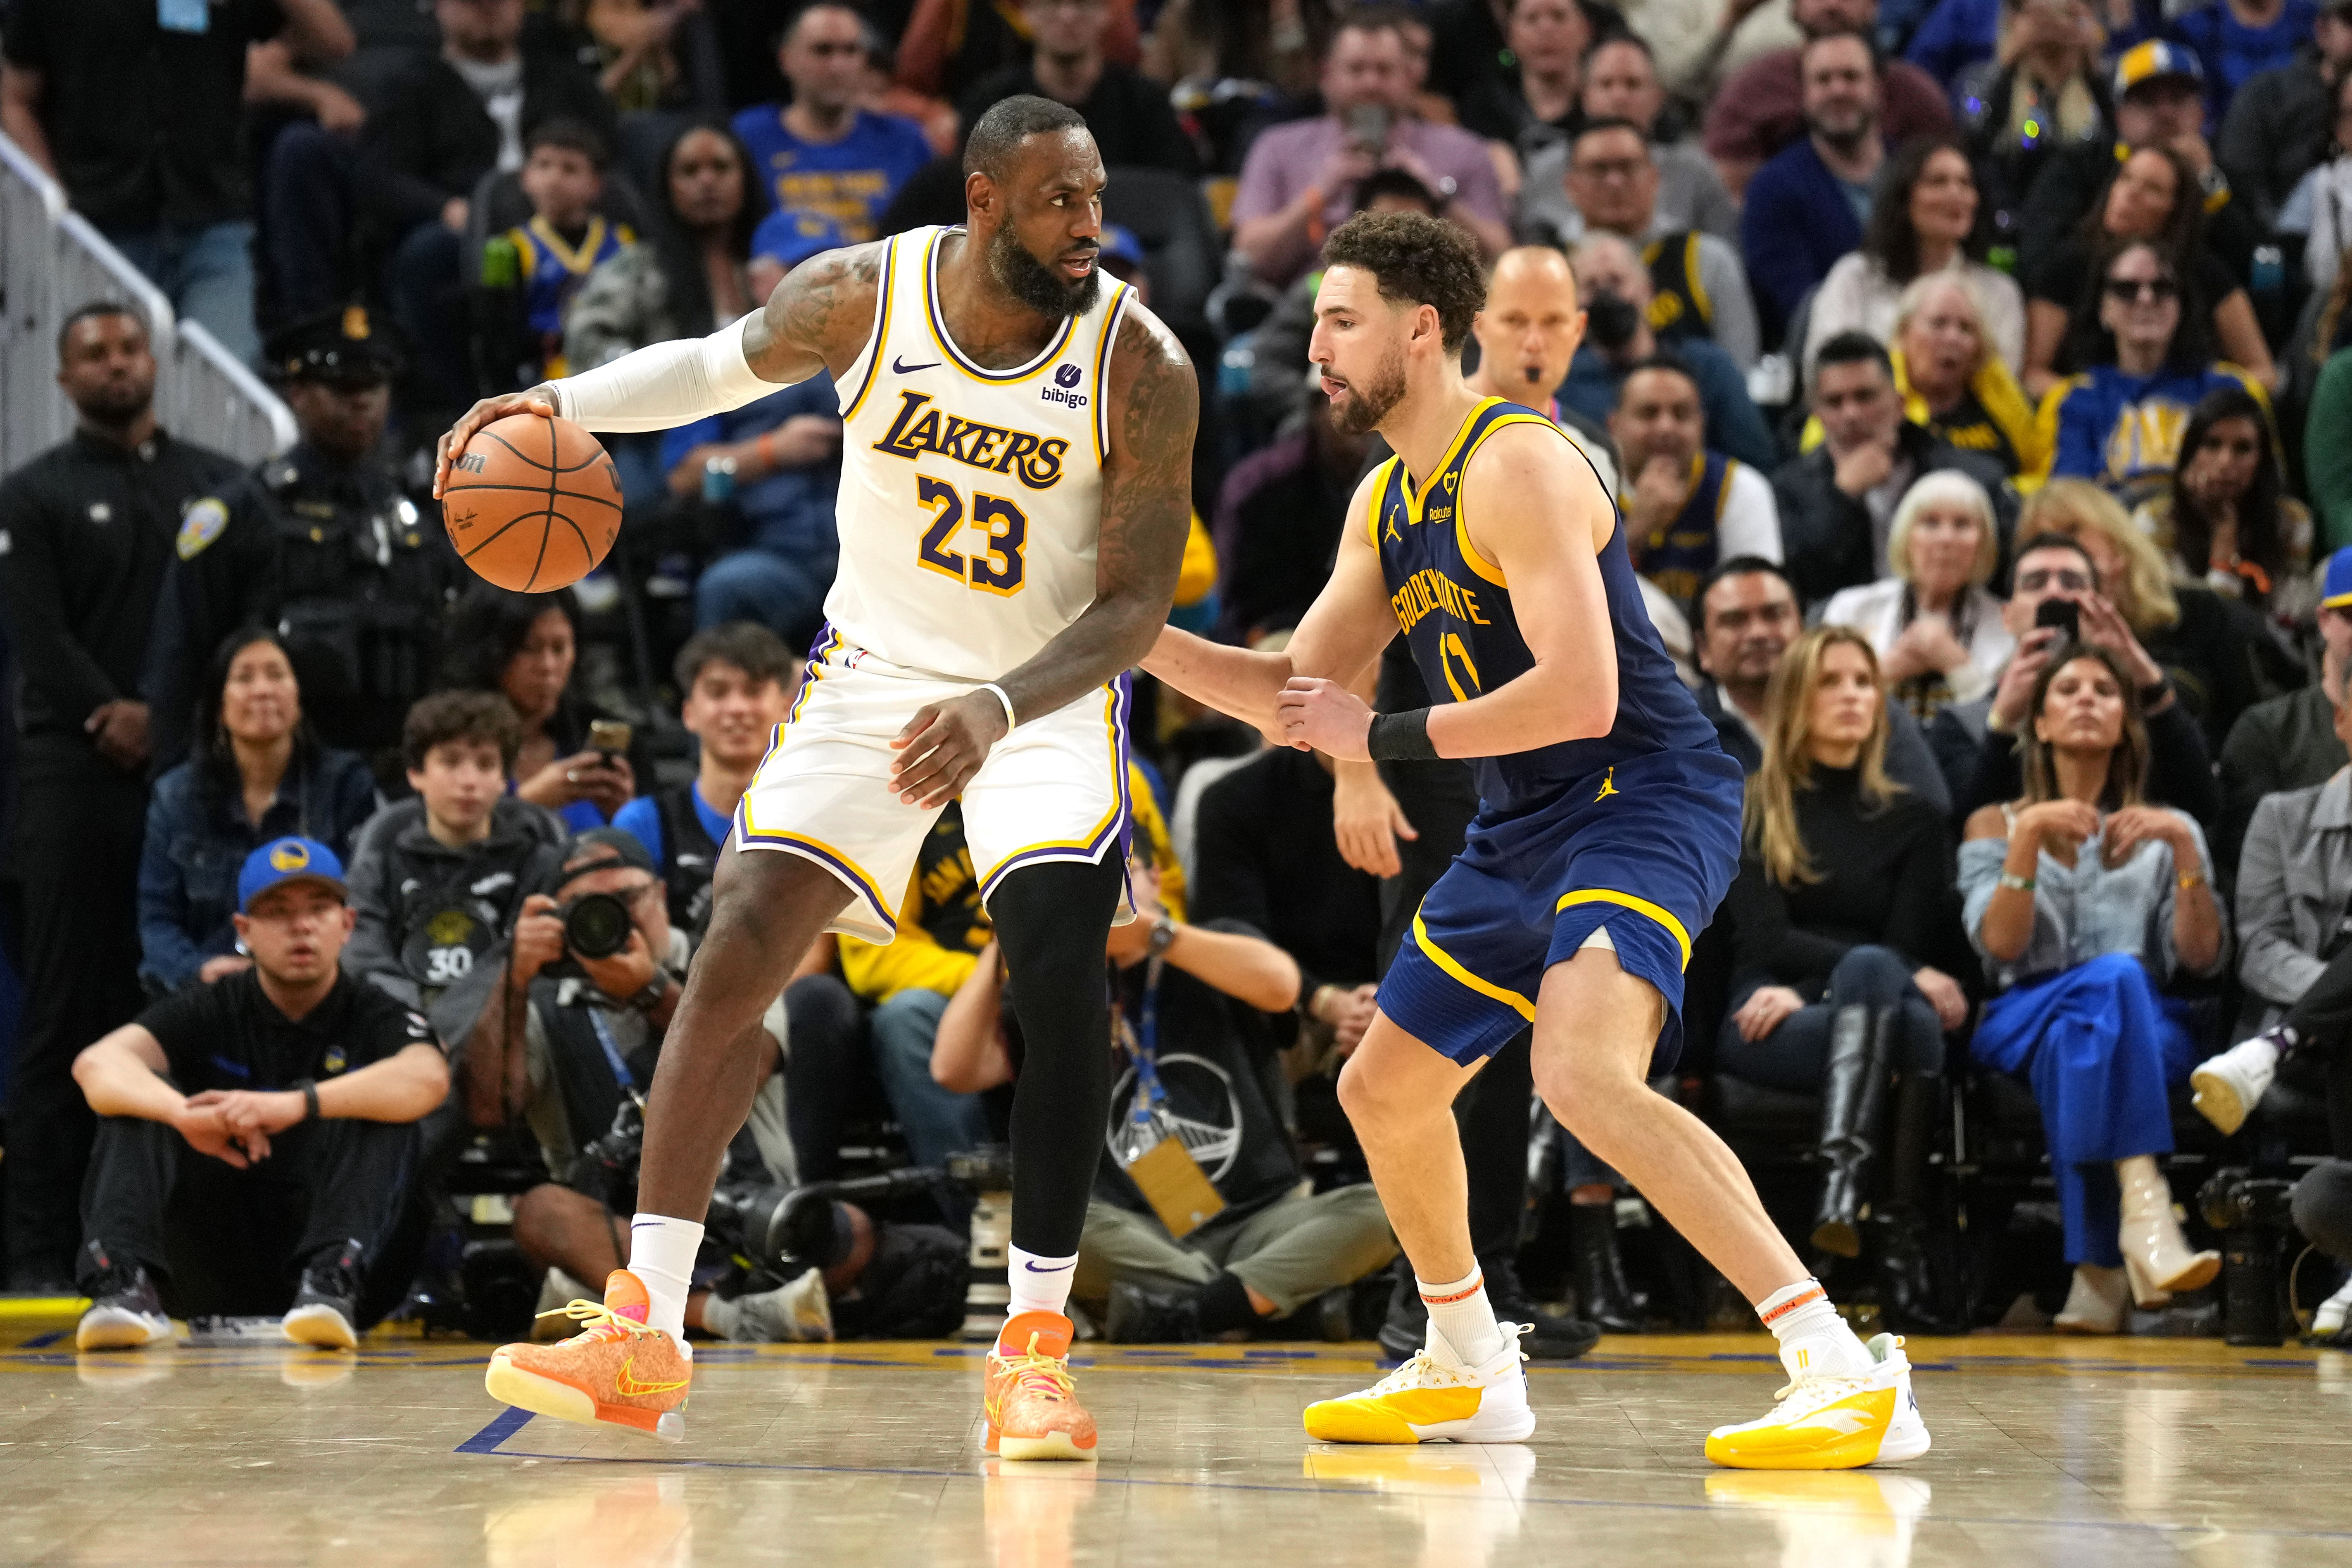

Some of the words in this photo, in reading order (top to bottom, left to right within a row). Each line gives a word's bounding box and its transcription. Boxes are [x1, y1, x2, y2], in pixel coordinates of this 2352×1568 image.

[1042, 387, 1087, 409] bibigo
[871, 388, 1071, 491] LAKERS
[1429, 505, 1452, 521] Rakute
[915, 473, 1028, 598] 23
[427, 946, 473, 981] 30
[1797, 1348, 1808, 1369] 11
